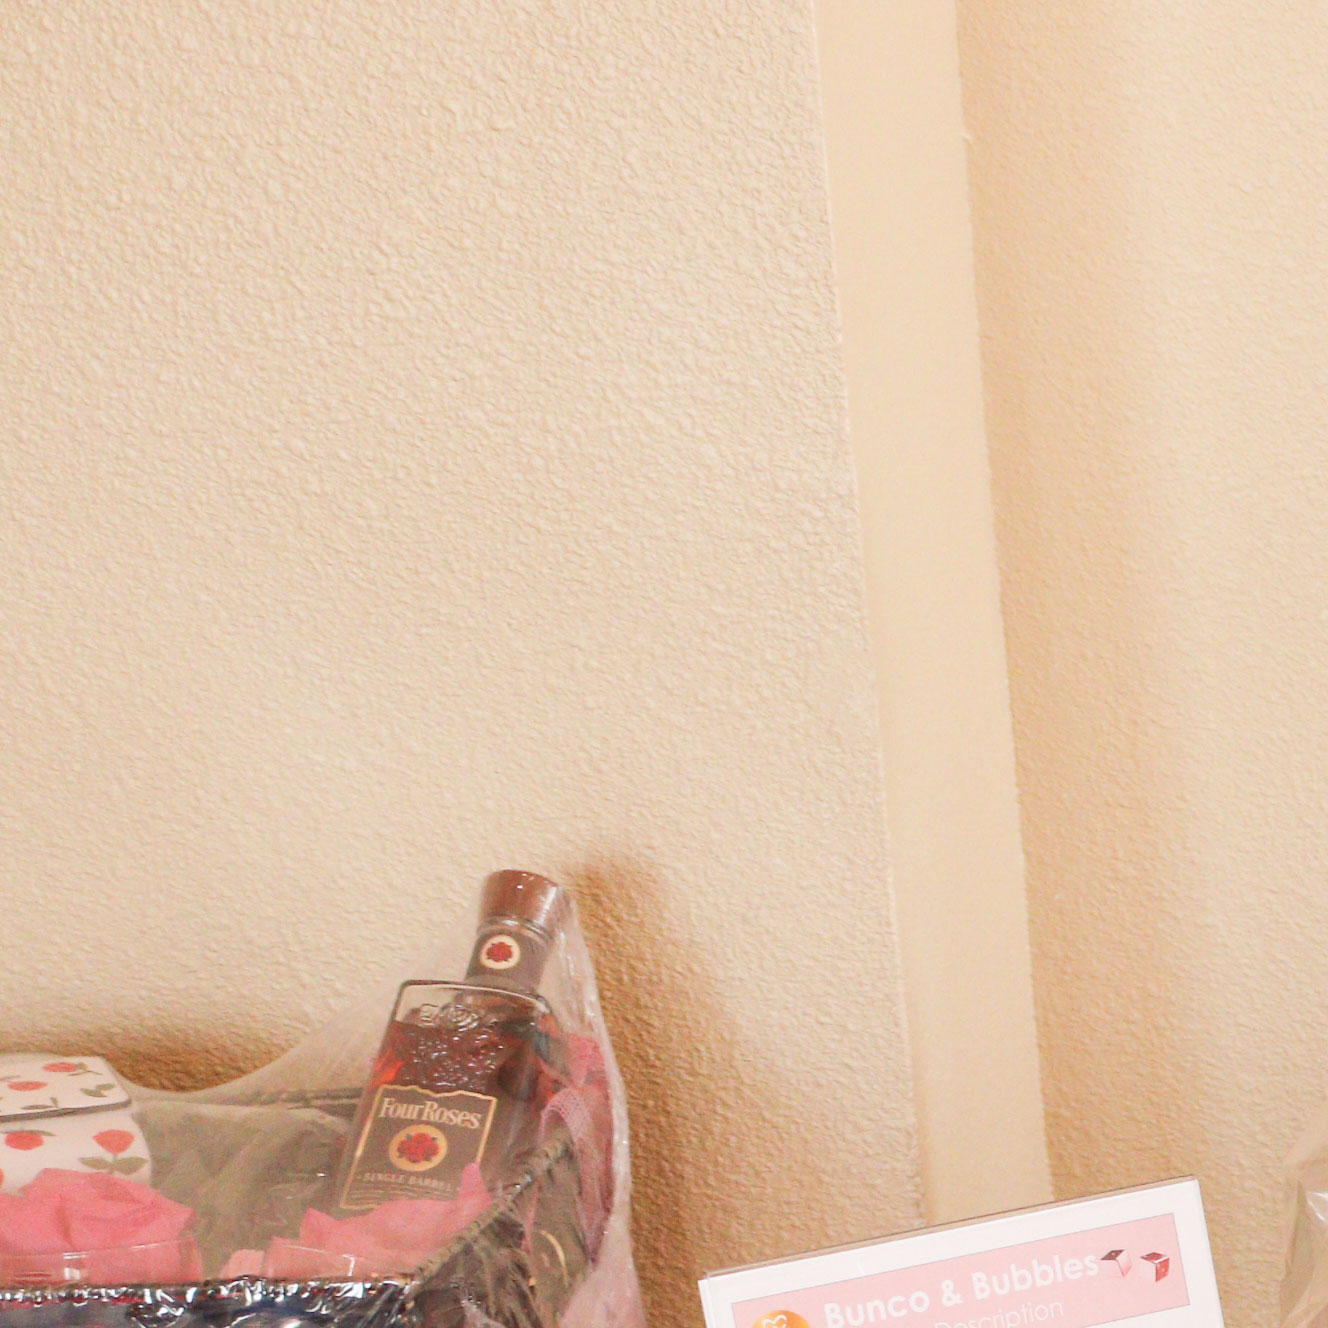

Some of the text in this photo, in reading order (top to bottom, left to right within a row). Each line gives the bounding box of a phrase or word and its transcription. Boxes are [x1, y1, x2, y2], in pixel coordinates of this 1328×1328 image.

[379, 1098, 482, 1129] Four Roses
[942, 1281, 963, 1306] &
[972, 1250, 1098, 1298] Bubbles
